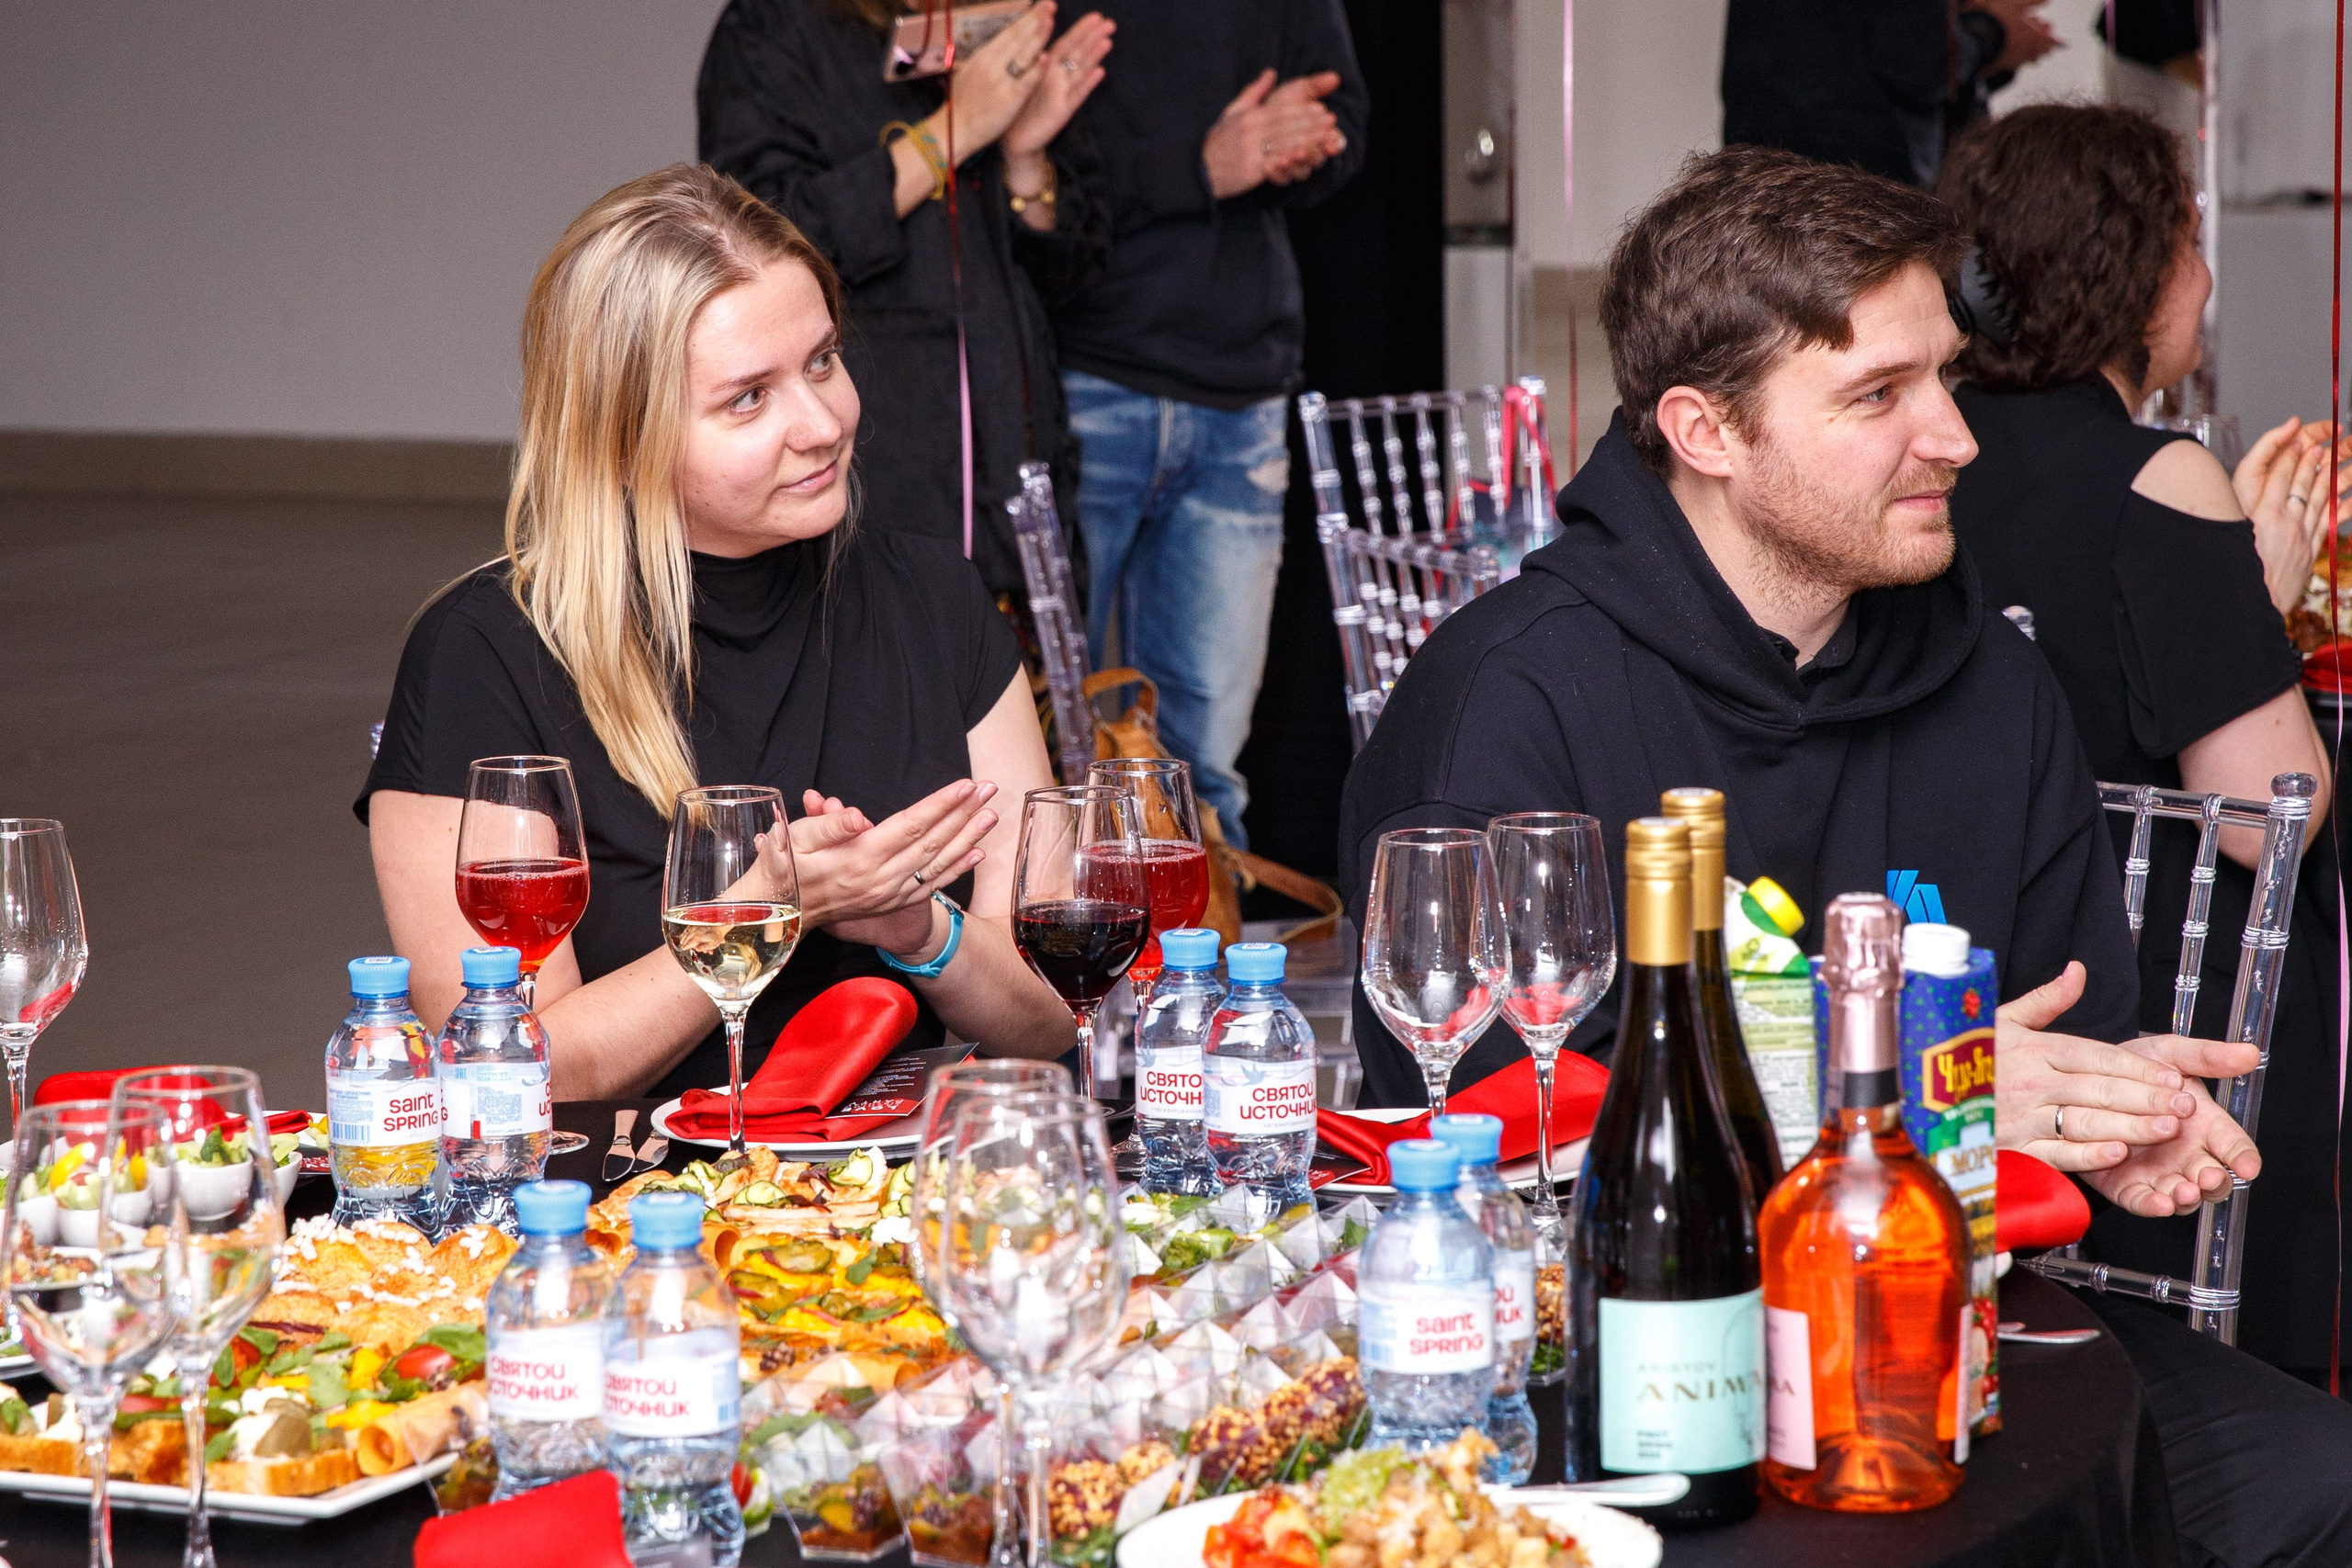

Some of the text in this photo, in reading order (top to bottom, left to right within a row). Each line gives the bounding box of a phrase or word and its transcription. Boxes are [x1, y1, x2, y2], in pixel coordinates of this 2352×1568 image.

[1147, 1070, 1203, 1088] СВЯТО
[1252, 1078, 1314, 1101] СВЯТОЙ
[1140, 1086, 1203, 1105] ИСТОЧН
[1951, 1145, 1995, 1176] МОР
[603, 1393, 690, 1417] СТОЧНИК
